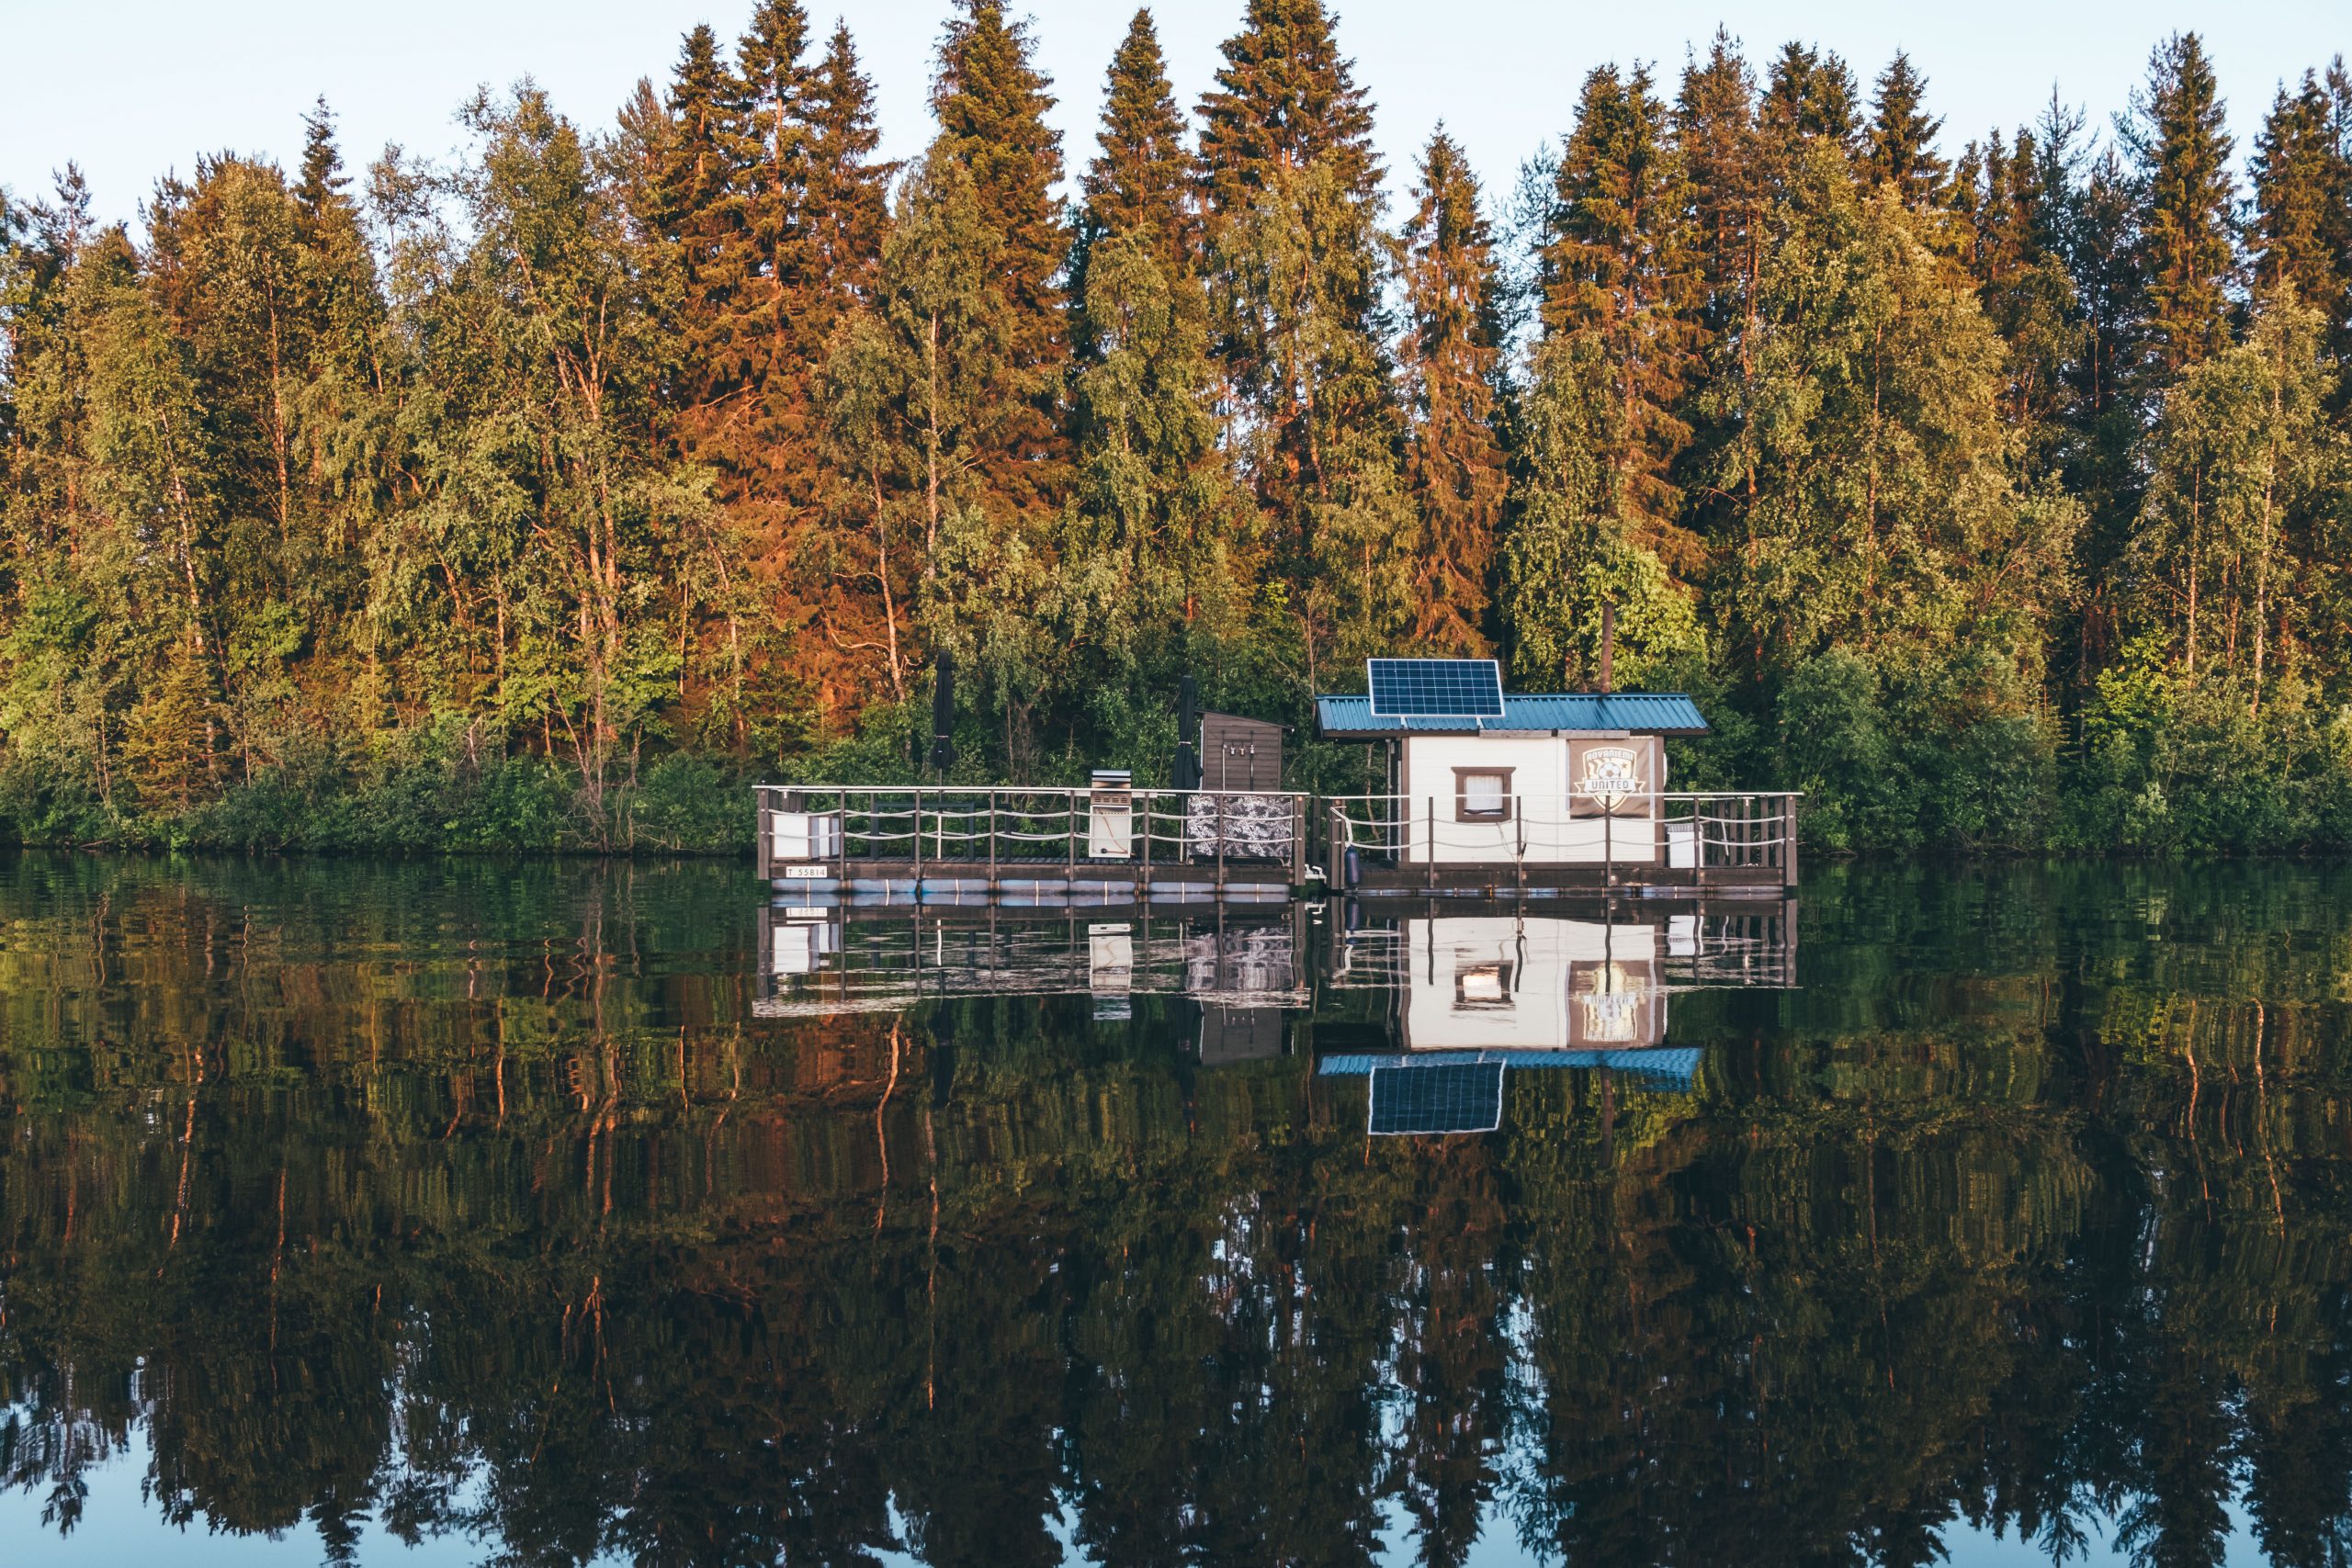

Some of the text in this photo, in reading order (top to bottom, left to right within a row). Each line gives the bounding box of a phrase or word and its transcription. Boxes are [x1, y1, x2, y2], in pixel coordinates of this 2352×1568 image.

[1587, 750, 1634, 761] ROVANIEMI
[1591, 781, 1629, 789] UNITED
[787, 868, 825, 876] T 55814
